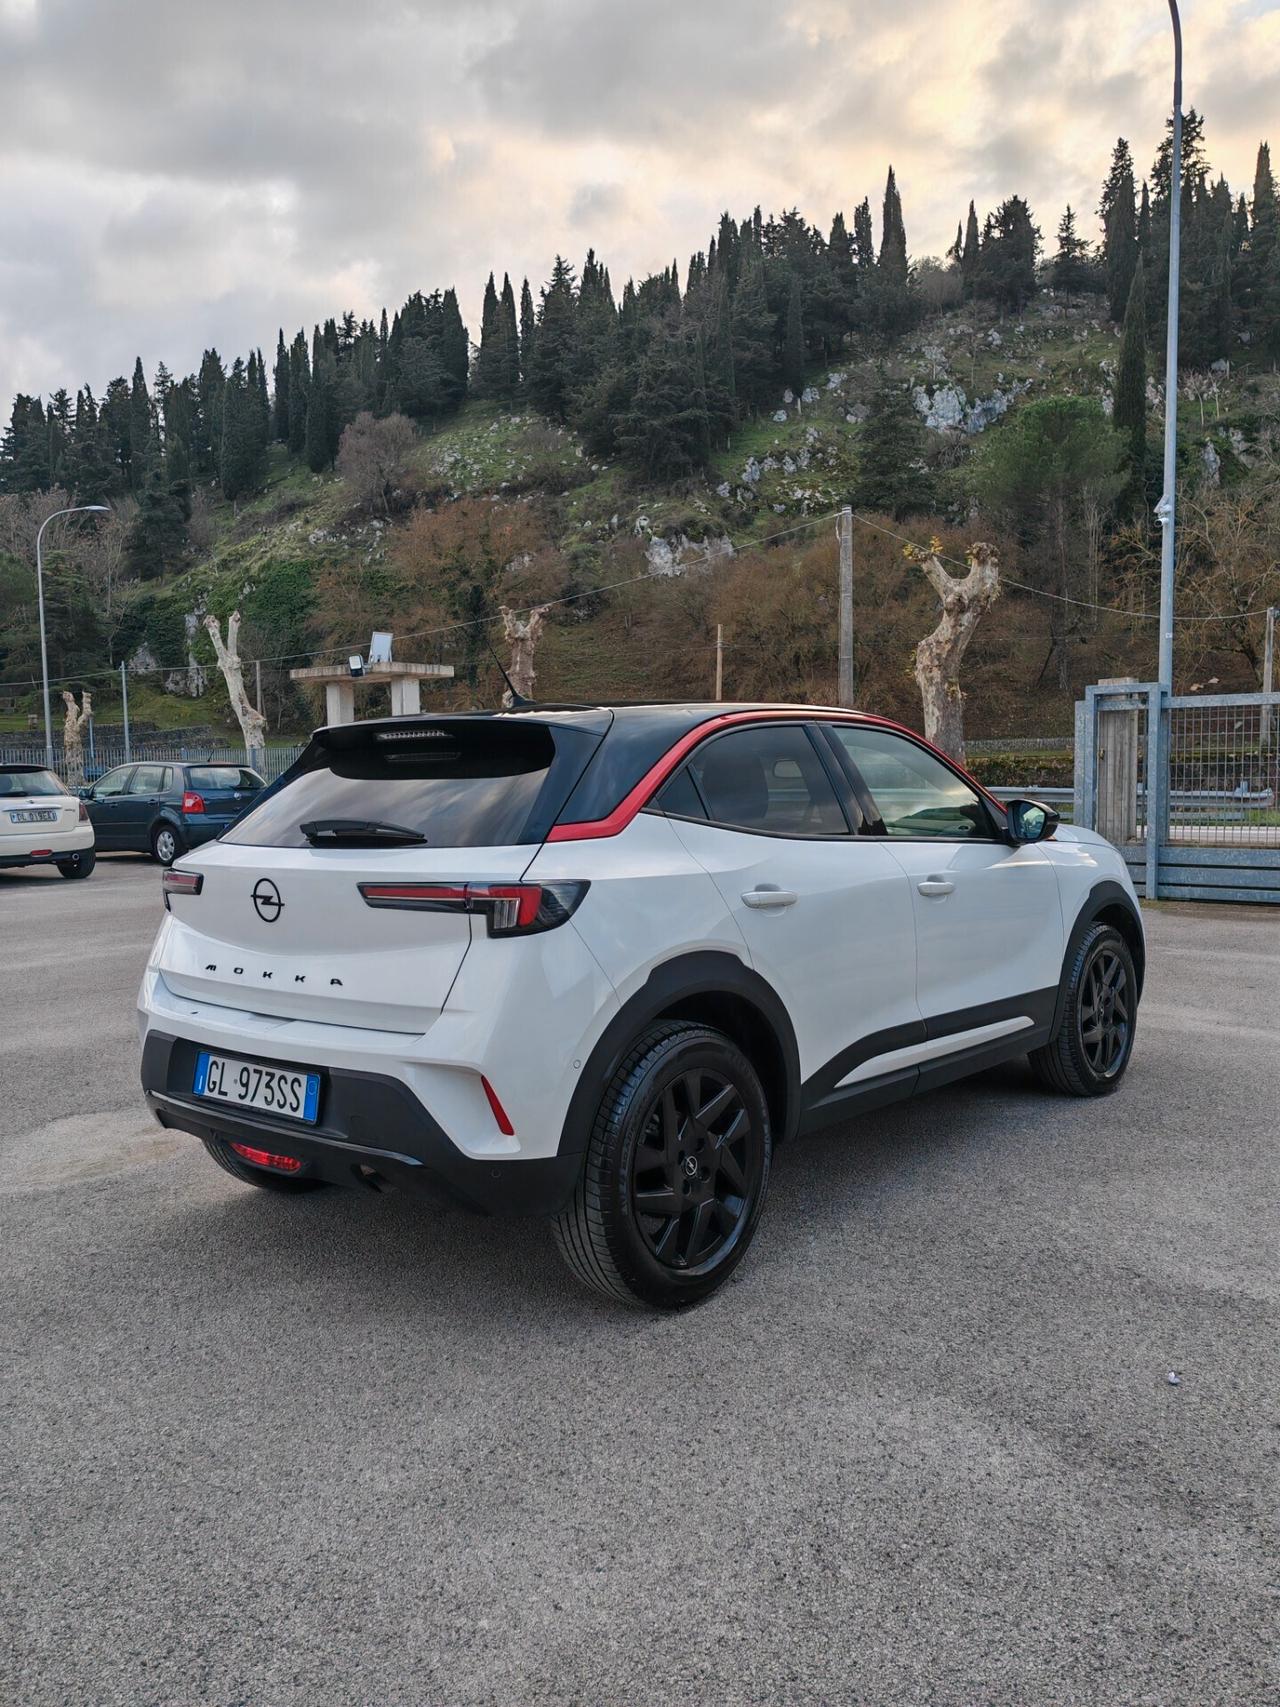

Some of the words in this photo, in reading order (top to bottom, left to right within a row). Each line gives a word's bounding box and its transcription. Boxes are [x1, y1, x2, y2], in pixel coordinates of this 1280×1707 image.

[205, 965, 343, 986] MOKKA
[207, 1060, 228, 1097] GL
[238, 1067, 302, 1113] 973SS
